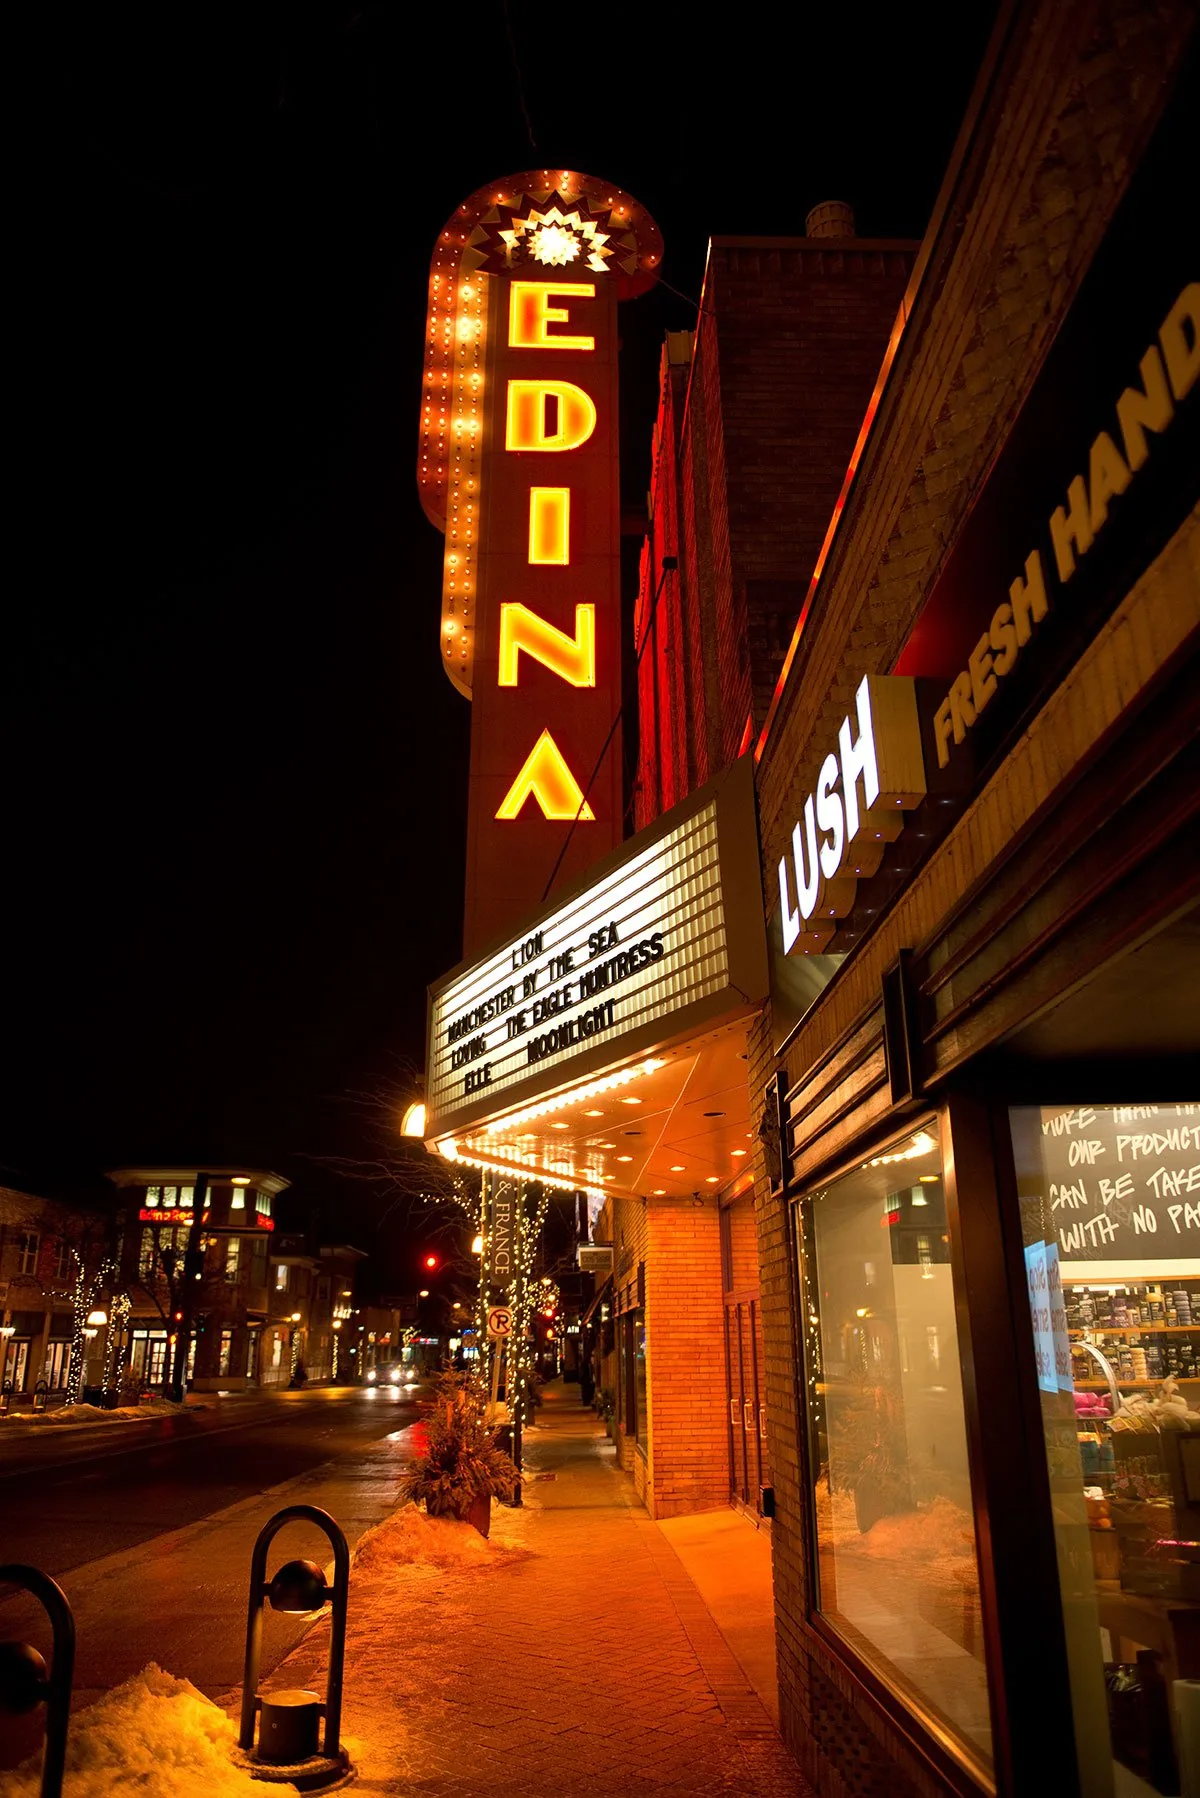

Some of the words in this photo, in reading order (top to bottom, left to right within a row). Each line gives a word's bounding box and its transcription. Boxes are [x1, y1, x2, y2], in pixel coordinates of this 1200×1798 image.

[496, 281, 597, 821] EDINA
[932, 548, 1050, 770] FRESH
[778, 673, 880, 956] LUSH
[447, 984, 516, 1044] MANCHESTER
[522, 968, 538, 996] BY
[548, 946, 575, 982] THE
[588, 921, 620, 958] SEA
[511, 930, 543, 970] LION
[450, 1031, 487, 1070] LOVING
[505, 1008, 528, 1041] THE
[533, 981, 573, 1023] EAGLE
[579, 932, 666, 997] HUNTRESS
[464, 1061, 492, 1096] ELLE
[527, 997, 617, 1064] MOONLIGHT
[495, 1180, 512, 1200] &
[1049, 1179, 1088, 1211] CAN
[1098, 1172, 1135, 1206] BE
[1146, 1164, 1200, 1199] TAKE
[1068, 1139, 1106, 1167] OUR
[495, 1203, 510, 1275] FRANCE
[1059, 1213, 1119, 1253] WITH
[1133, 1204, 1157, 1234] NO
[1167, 1202, 1200, 1235] PA
